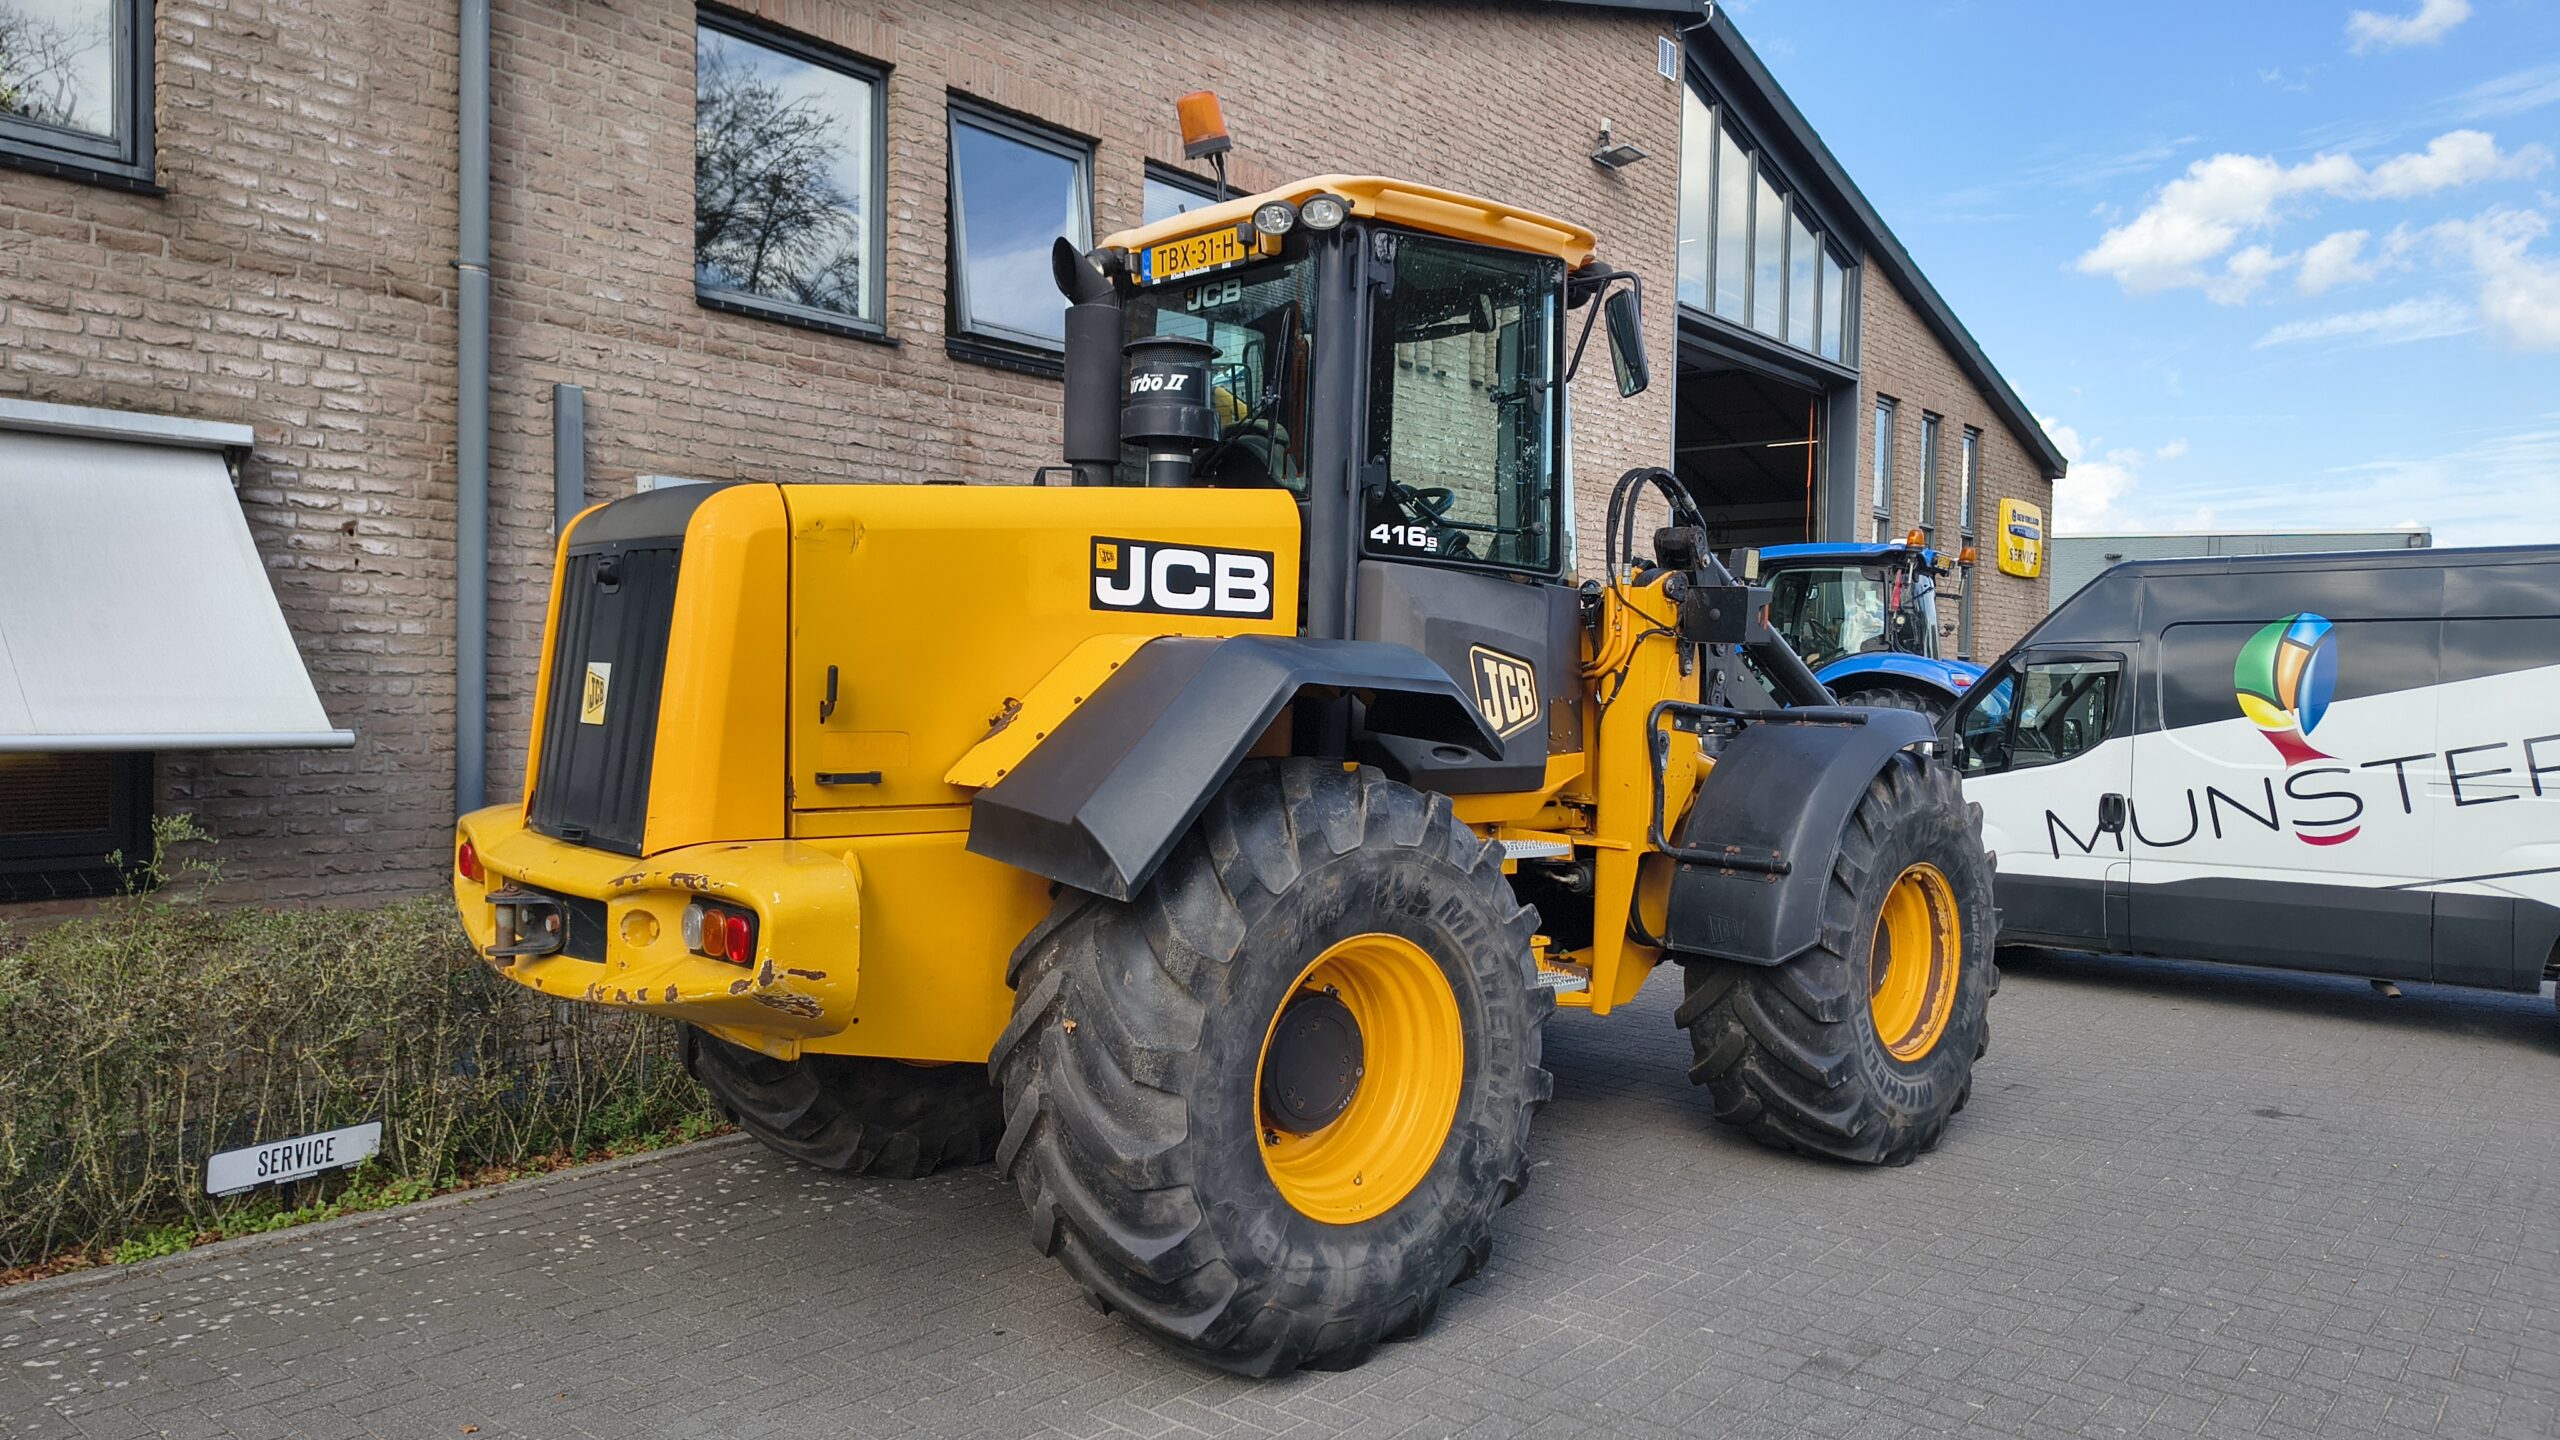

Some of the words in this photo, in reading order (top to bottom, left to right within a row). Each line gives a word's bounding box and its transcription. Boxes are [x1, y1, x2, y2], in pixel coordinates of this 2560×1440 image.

[1158, 233, 1234, 273] TBX-31-H
[1187, 279, 1241, 311] JCB
[1130, 374, 1164, 394] urbo
[1164, 373, 1189, 391] II
[1101, 549, 1115, 563] JCB
[2010, 547, 2037, 565] SERVICE
[1096, 545, 1270, 613] JCB
[588, 676, 605, 709] JCB
[1482, 657, 1534, 731] JCB
[1434, 894, 1513, 1124] MICHELIN
[1858, 1016, 1933, 1109] MICHELIN
[257, 1136, 336, 1177] SERVICE
